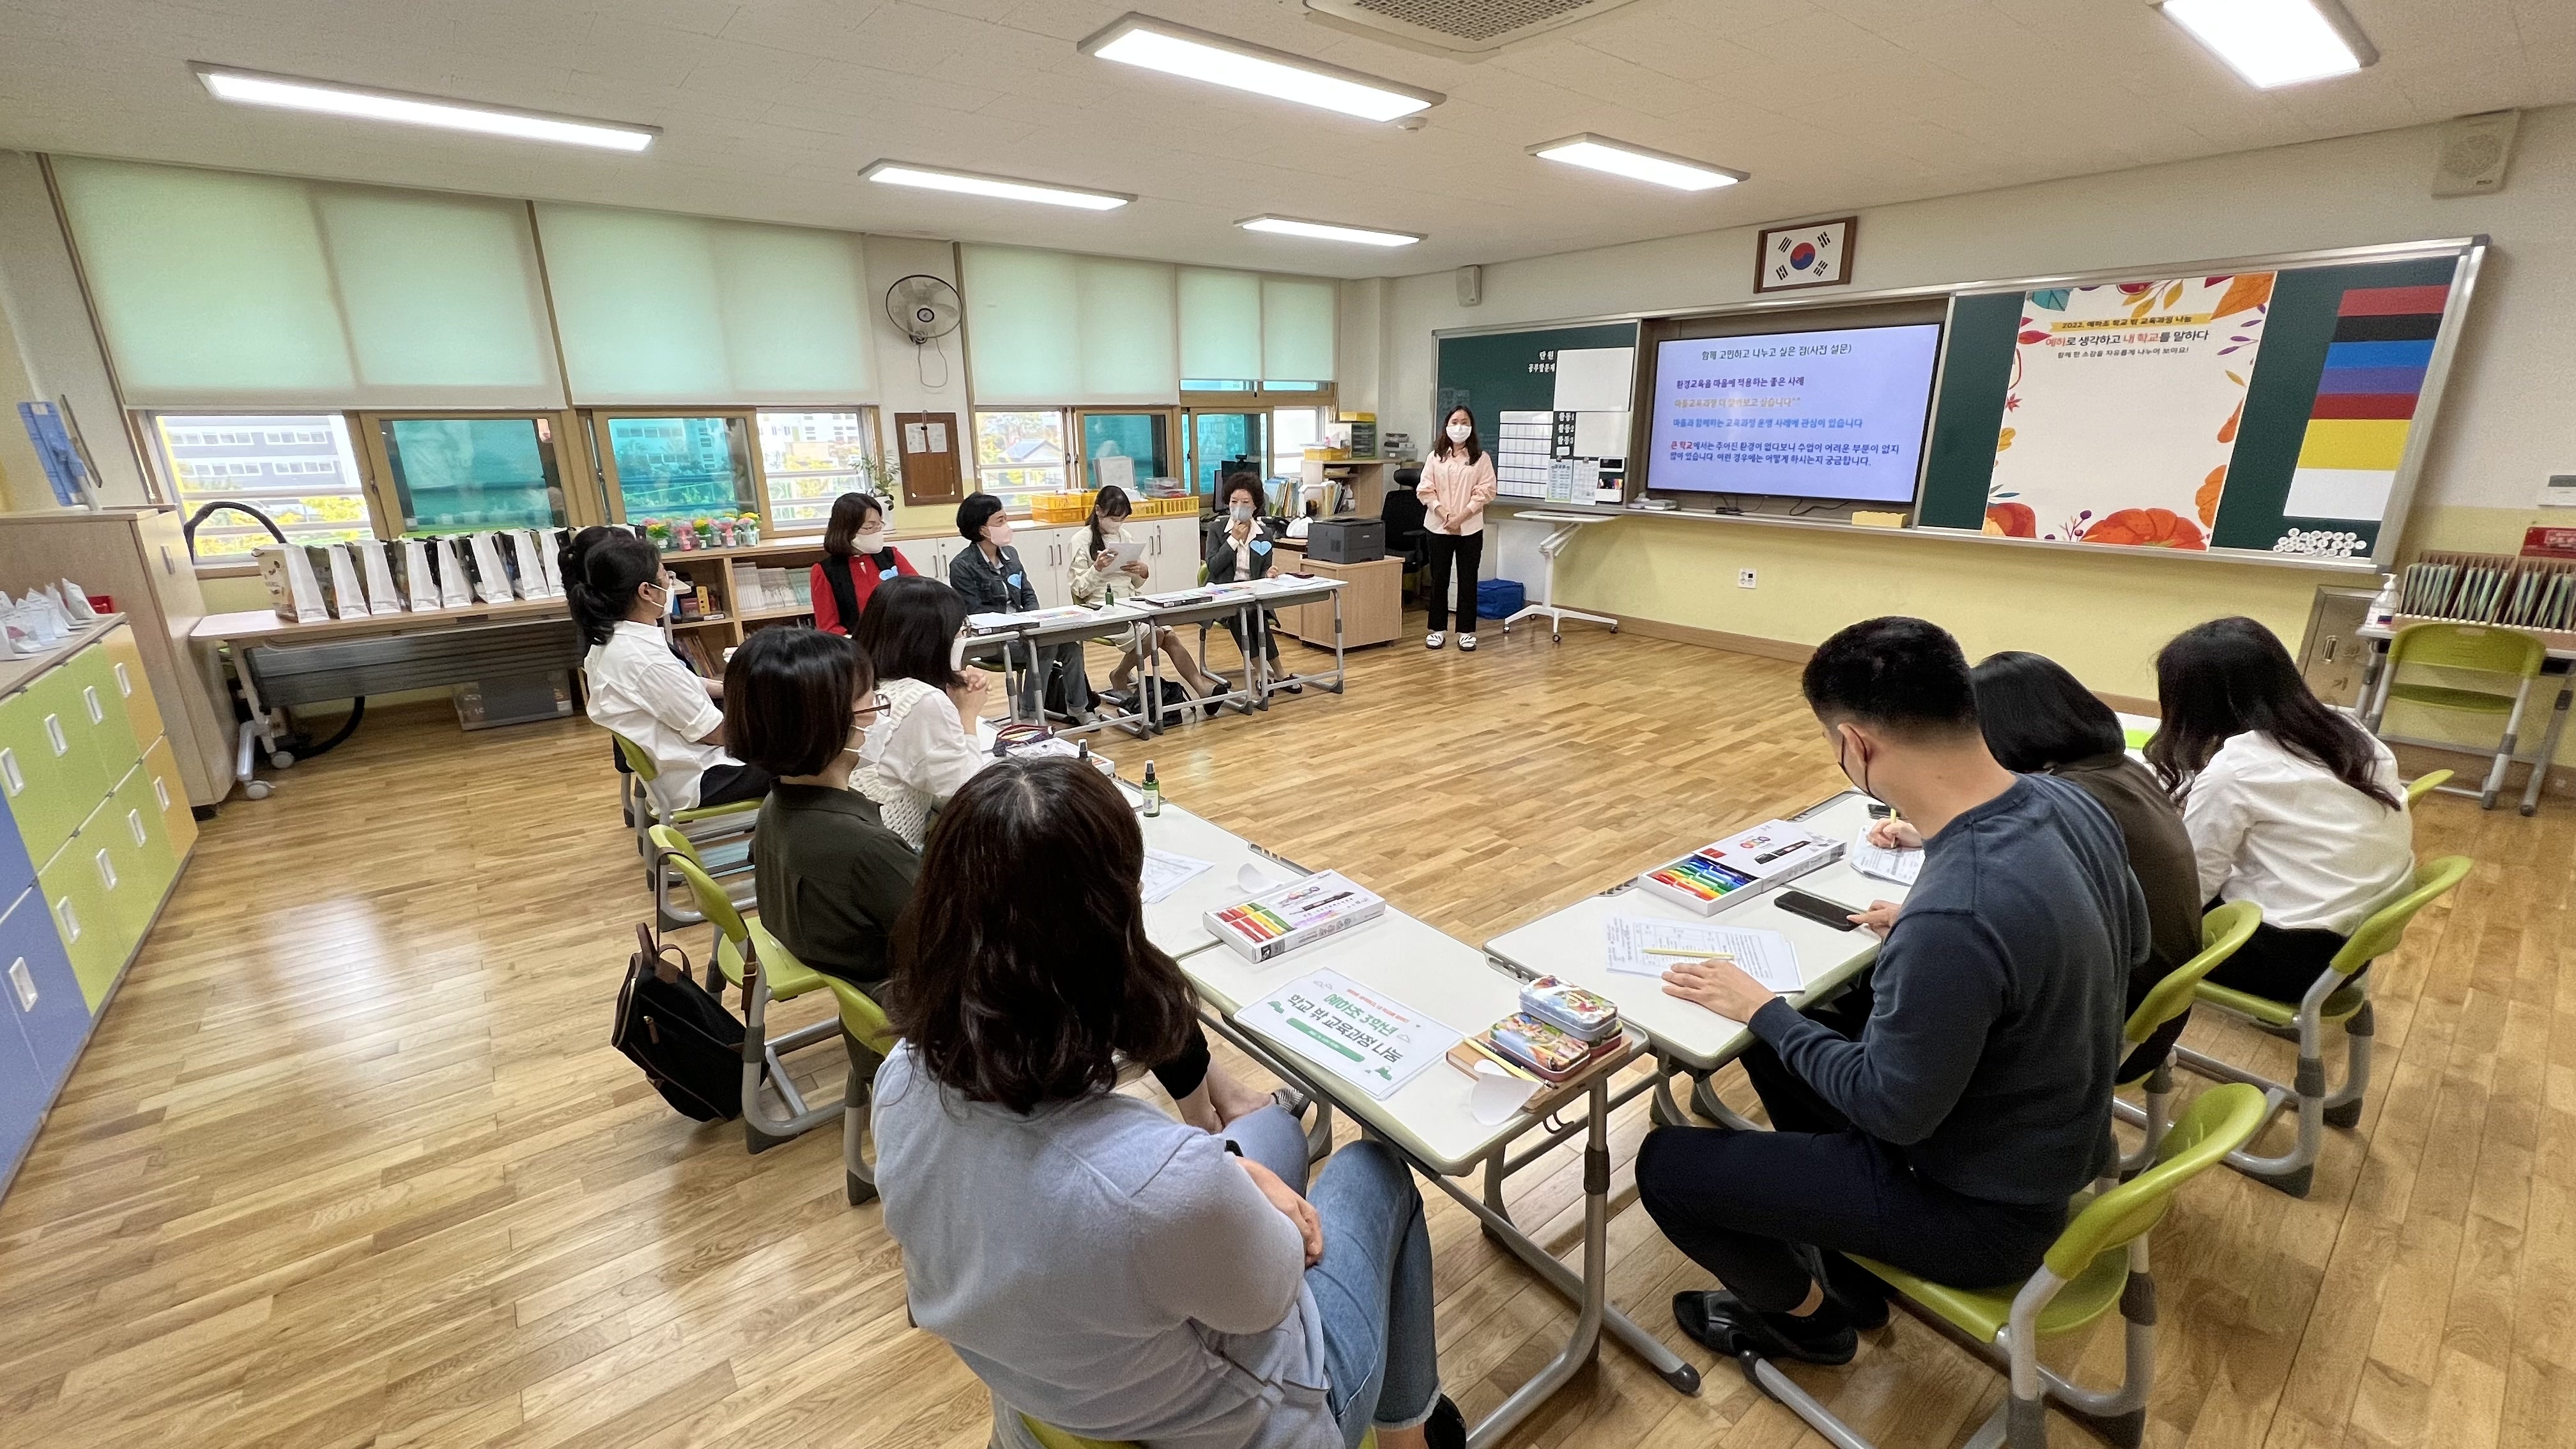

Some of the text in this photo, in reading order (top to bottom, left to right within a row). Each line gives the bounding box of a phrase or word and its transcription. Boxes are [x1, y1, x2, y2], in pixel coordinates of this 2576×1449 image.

[2078, 335, 2121, 346] 생각하고
[2123, 333, 2135, 344] 내
[2137, 332, 2171, 343] 학교를
[2174, 330, 2209, 342] 말하다
[1702, 344, 1852, 360] 함께 고민하고 나누고 싶은 점(사전 설문)
[1676, 376, 1804, 388] 환경교육을 마을에 적용하는 좋은 사례
[1675, 399, 1717, 408] 마을교육과정
[1673, 418, 1863, 428] 마을과 함께하는 교육과정 운영 사례에 관심이 있습니다
[1671, 441, 1678, 450] 큰
[1679, 441, 1714, 450] 학교에서는
[1716, 441, 1738, 451] 주어진
[1740, 442, 1762, 452] 환경이
[1798, 443, 1822, 452] 수업이
[1825, 443, 1850, 454] 어려운
[1853, 443, 1879, 454] 부분이
[1882, 444, 1899, 455] 없지
[1717, 452, 1731, 463] 이런
[1733, 454, 1763, 463] 경우에는
[1765, 454, 1789, 464] 어떻게
[1791, 455, 1823, 465] 하시는지
[1825, 456, 1871, 466] 궁금합니다.
[1287, 993, 1315, 1015] 학교
[1309, 1006, 1330, 1022] 밖
[1321, 1015, 1378, 1048] 교육과정
[1372, 1040, 1404, 1063] 나눔
[1360, 1014, 1399, 1038] 3학년
